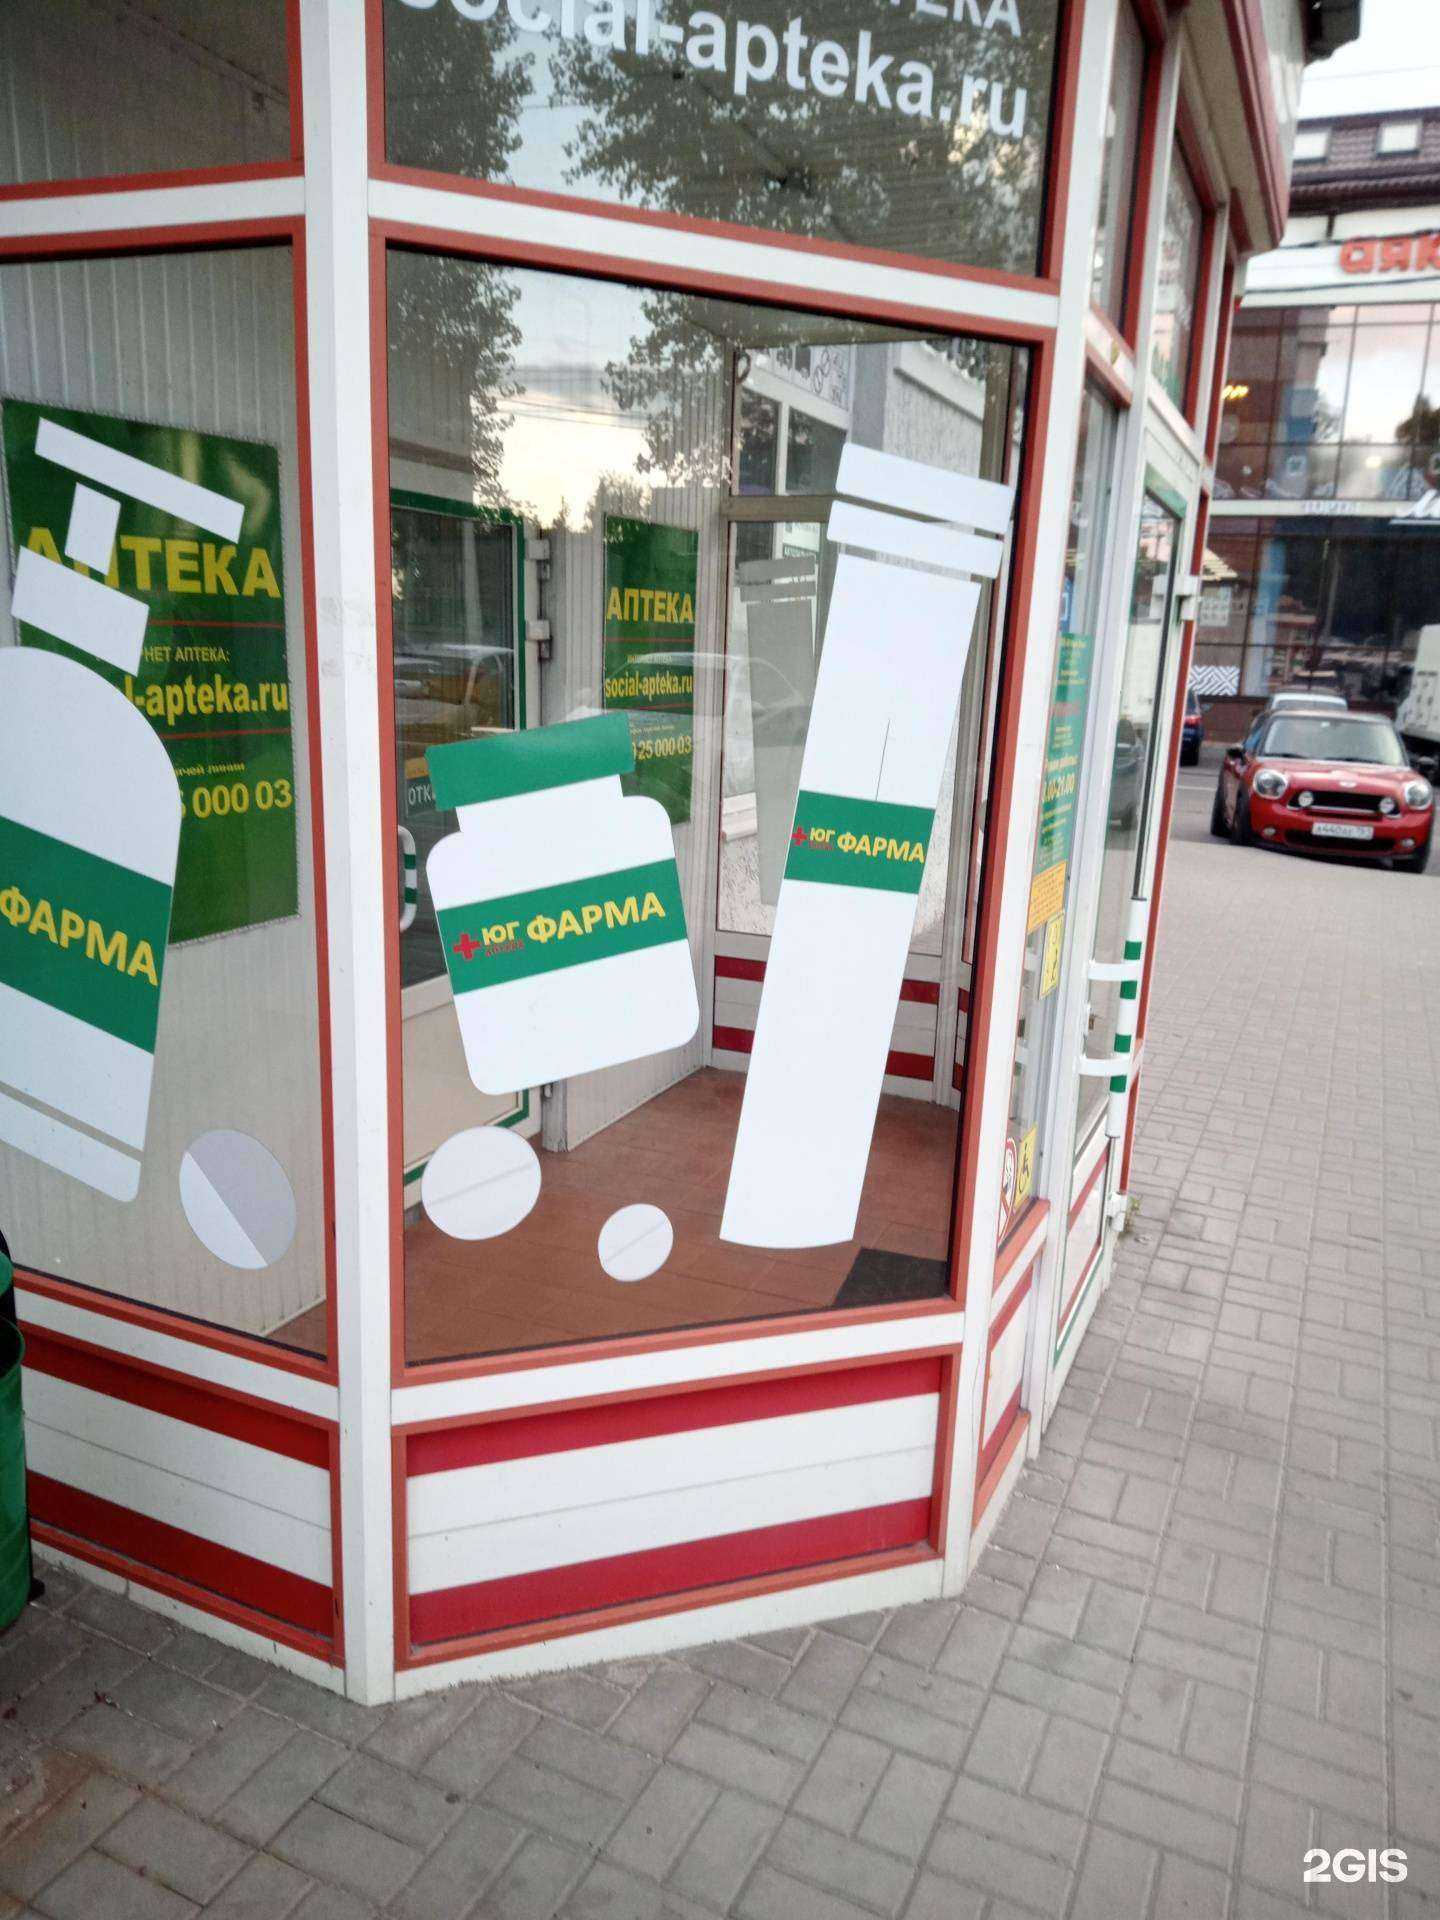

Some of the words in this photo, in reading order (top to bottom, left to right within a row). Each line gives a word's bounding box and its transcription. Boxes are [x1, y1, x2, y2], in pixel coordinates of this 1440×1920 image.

[606, 586, 694, 625] АПТЕКА
[605, 669, 694, 702] social-apteka.ru
[193, 781, 249, 819] 000
[255, 777, 292, 811] 03
[809, 827, 836, 843] ЮГ
[836, 831, 926, 864] ФАРМА
[0, 885, 158, 987] ФАРМА
[481, 920, 520, 946] ЮГ
[526, 891, 667, 945] ФАРМА
